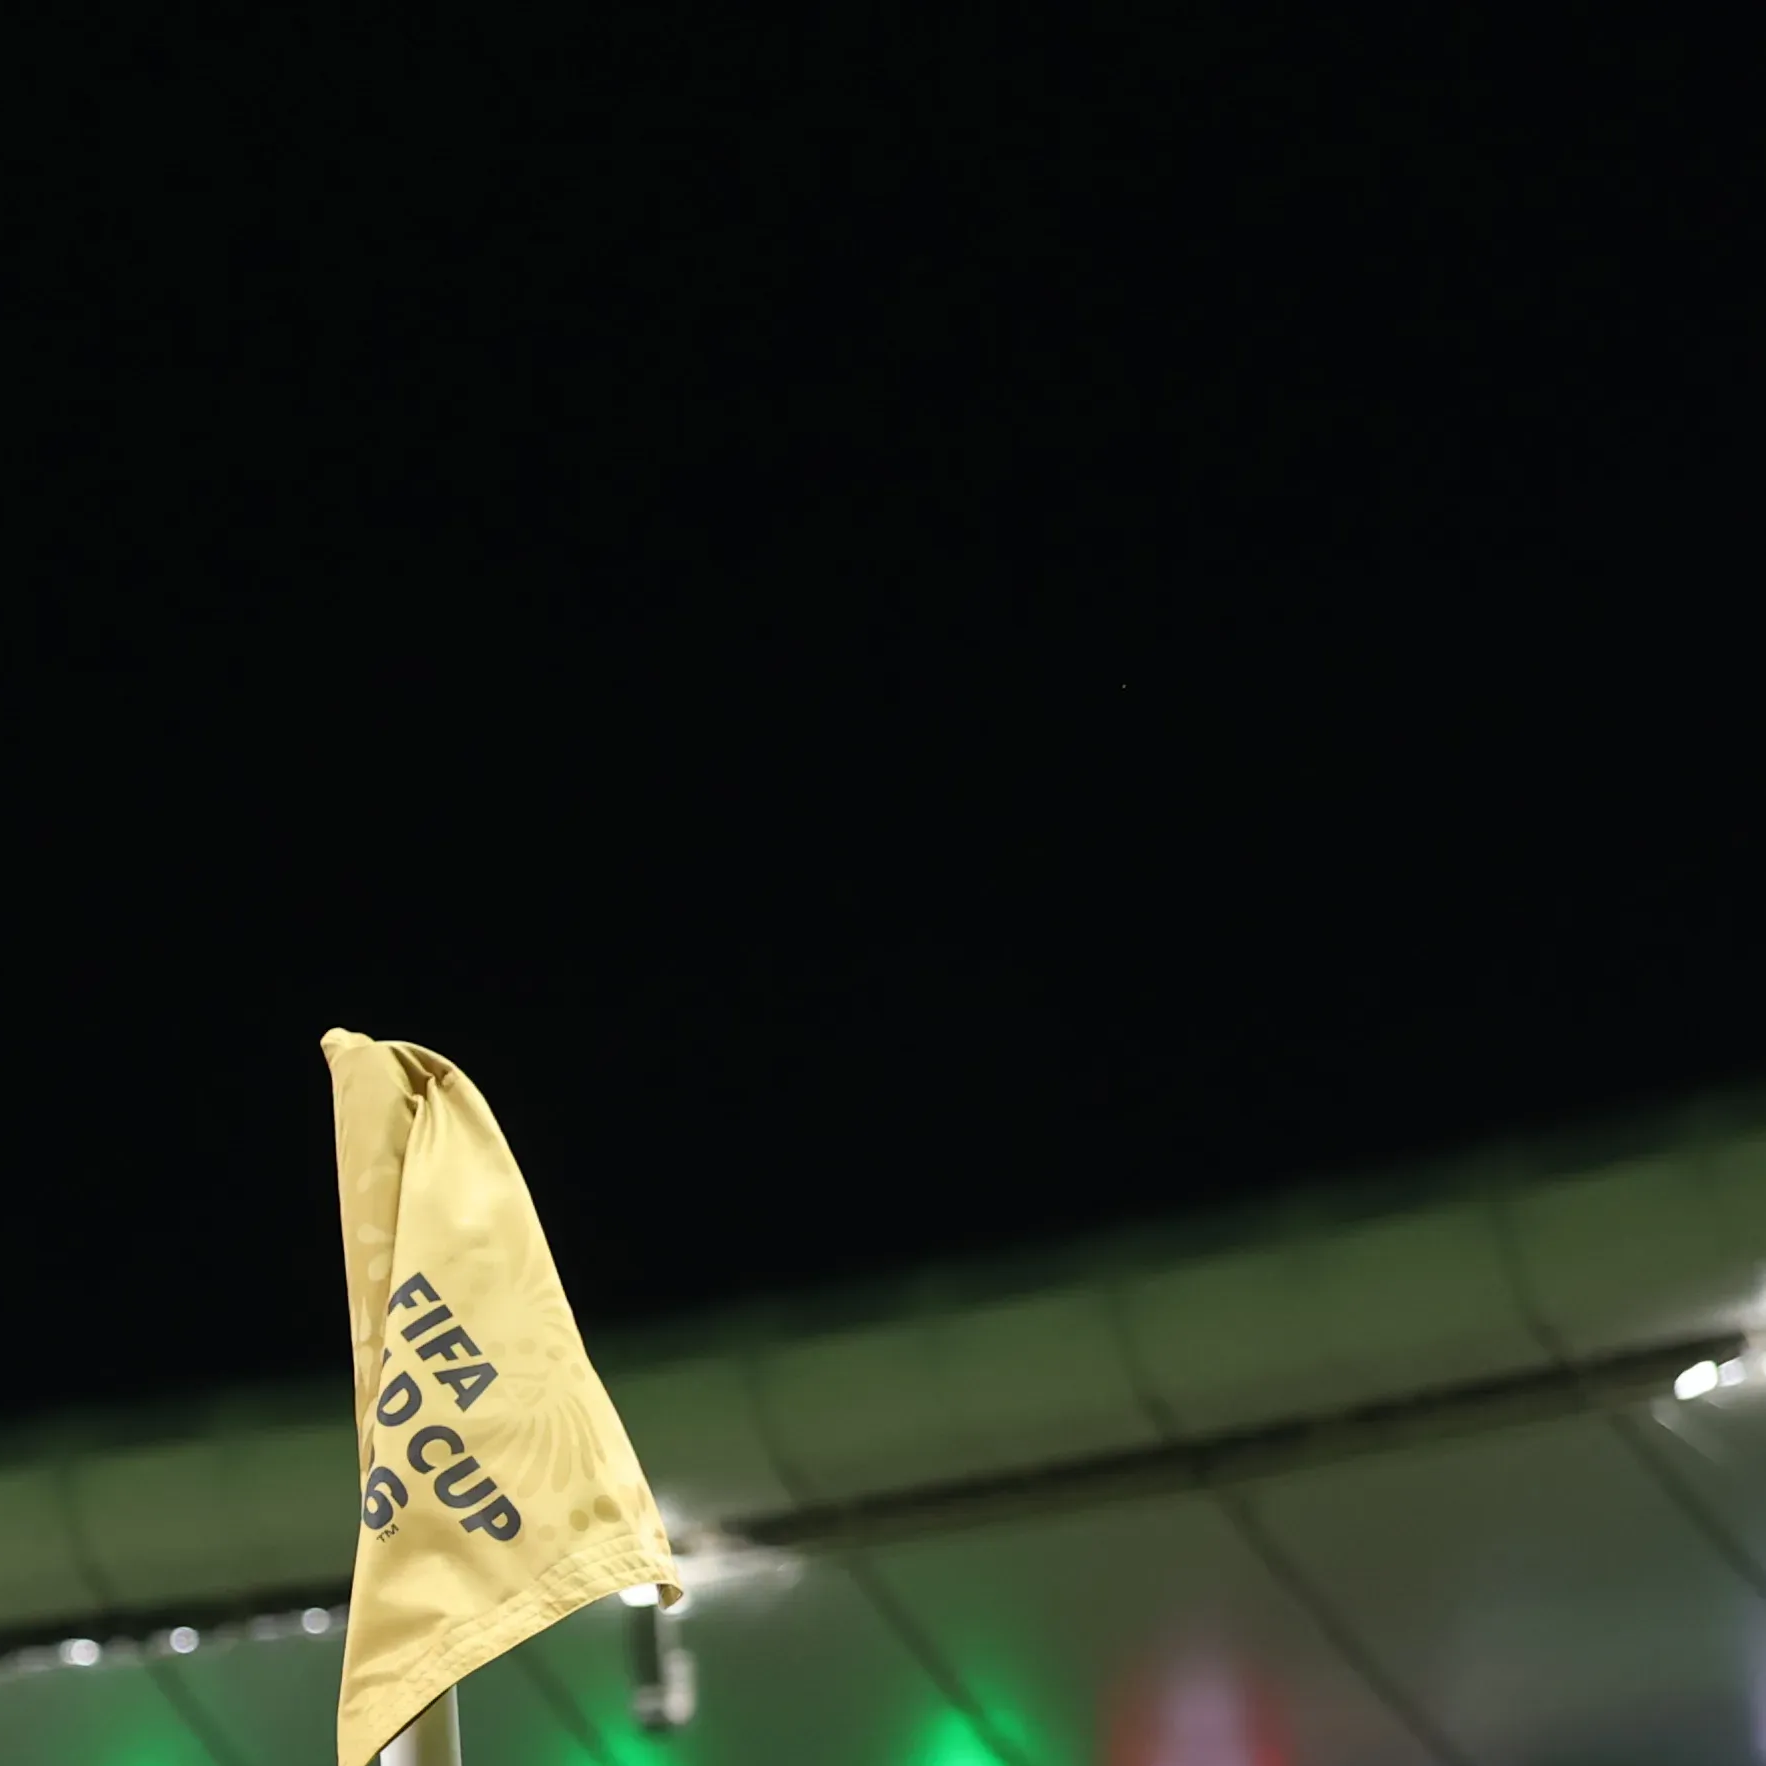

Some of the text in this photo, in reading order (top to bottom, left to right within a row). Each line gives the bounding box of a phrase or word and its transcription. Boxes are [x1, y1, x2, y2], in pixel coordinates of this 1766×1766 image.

[388, 1272, 499, 1412] FIFA
[363, 1460, 409, 1530] 6
[377, 1348, 521, 1543] D CUP
